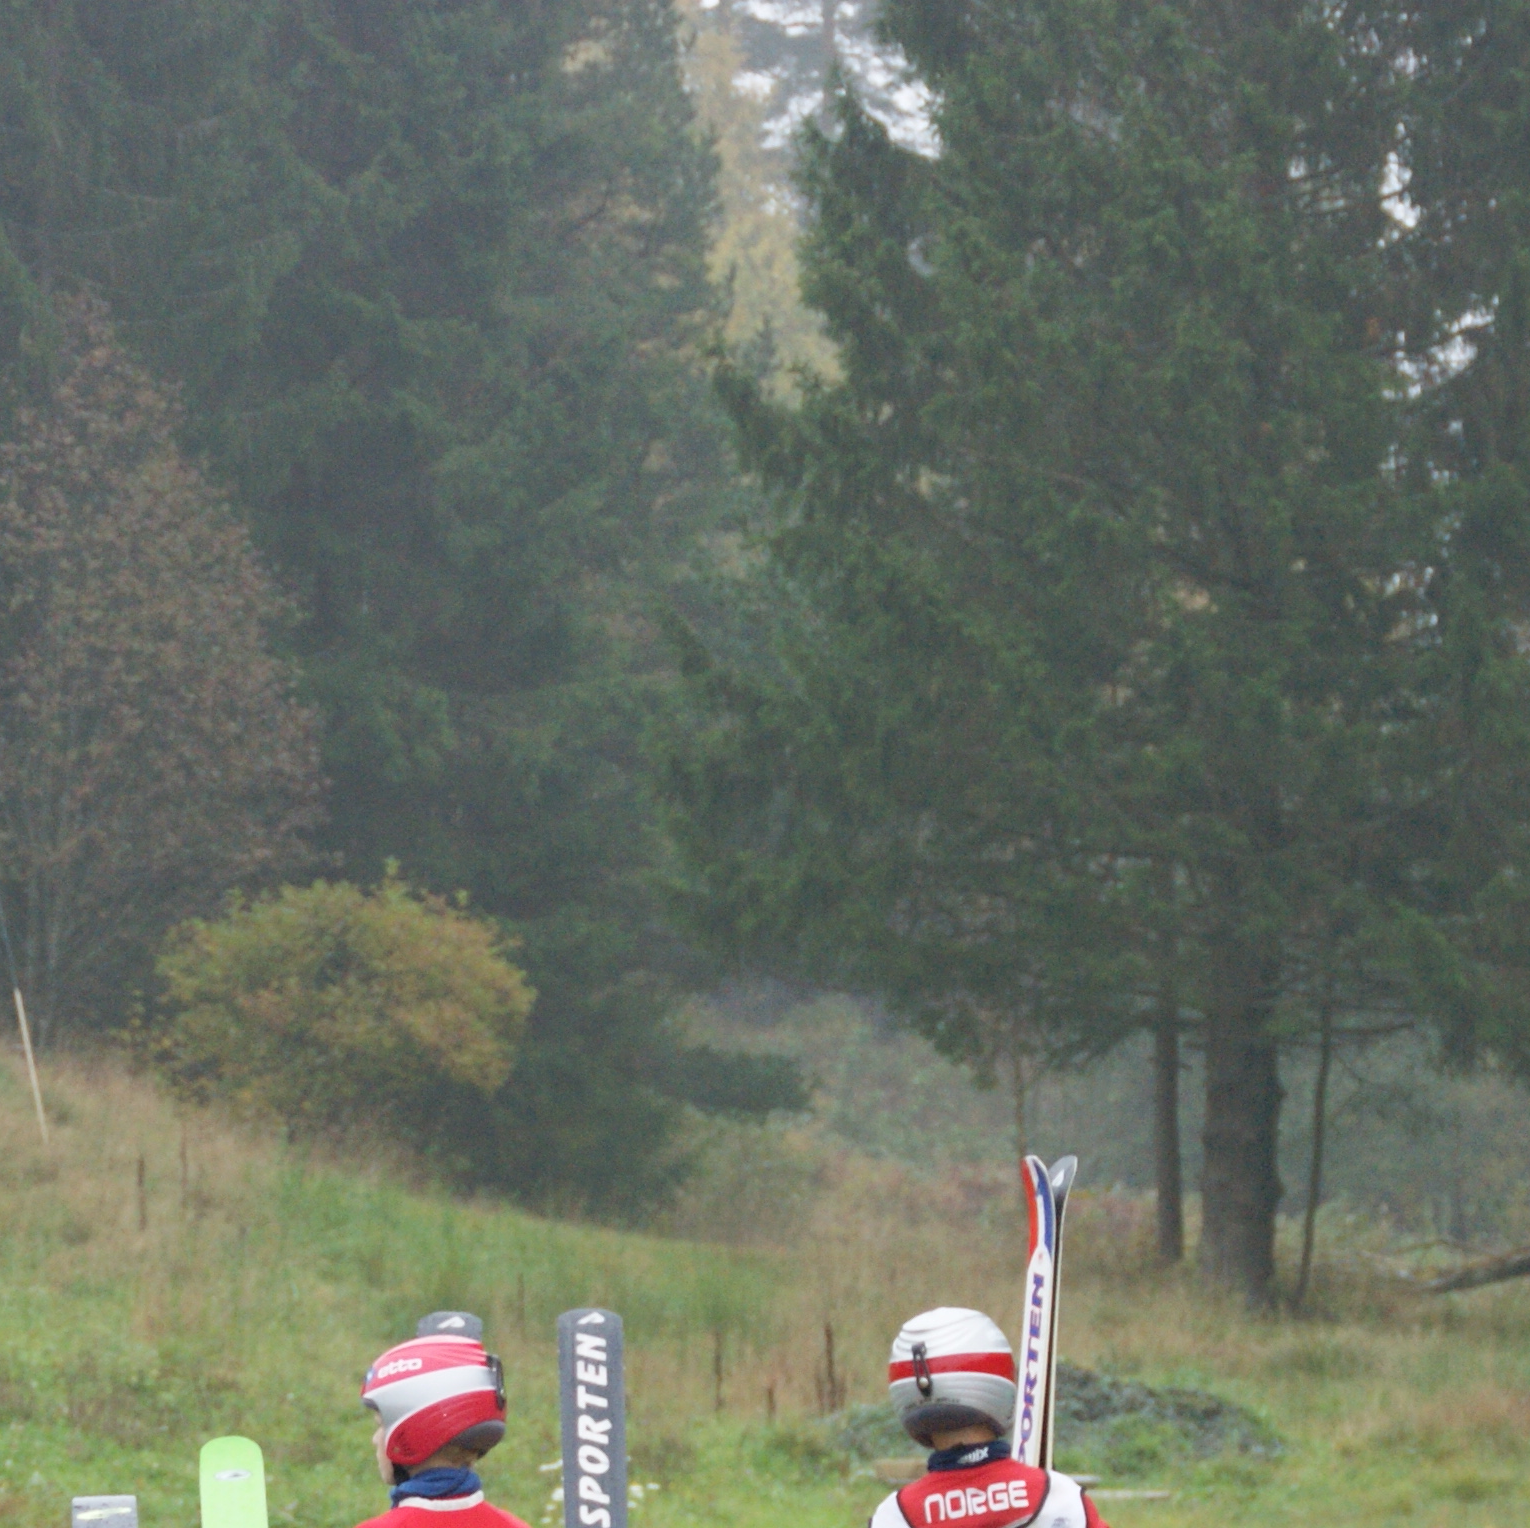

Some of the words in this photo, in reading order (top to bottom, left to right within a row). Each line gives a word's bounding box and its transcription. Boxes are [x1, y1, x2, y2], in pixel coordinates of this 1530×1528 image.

[377, 1358, 423, 1379] etto
[575, 1333, 612, 1528] SPORTEN
[924, 1480, 1029, 1524] NORGE
